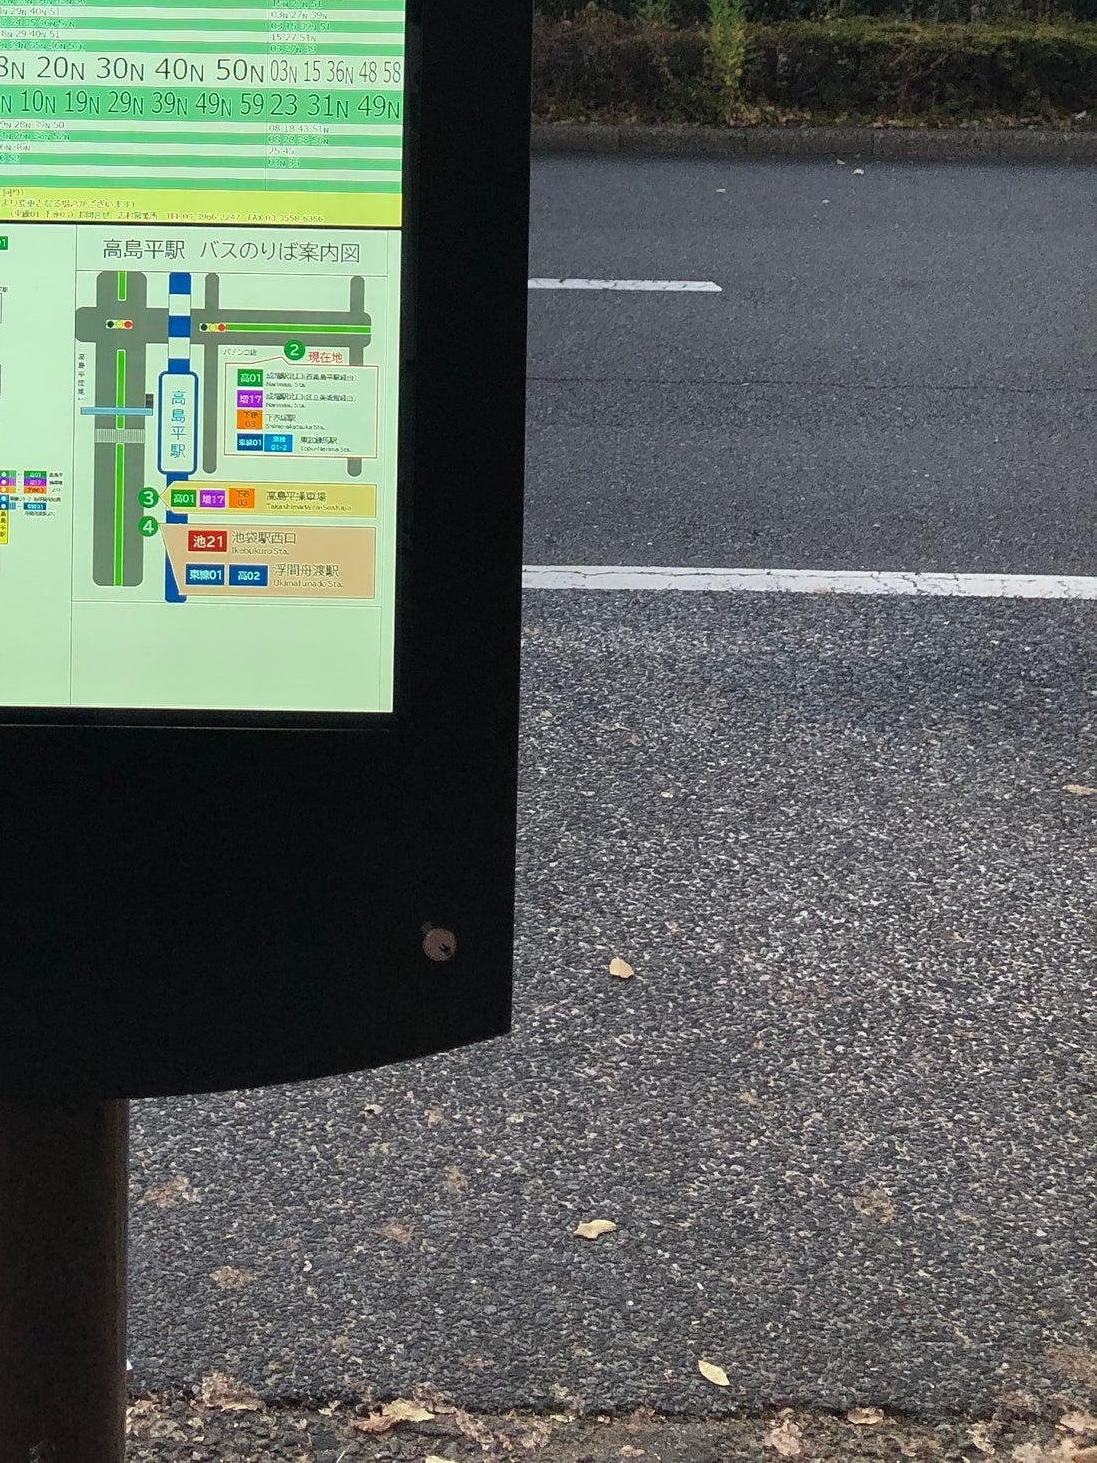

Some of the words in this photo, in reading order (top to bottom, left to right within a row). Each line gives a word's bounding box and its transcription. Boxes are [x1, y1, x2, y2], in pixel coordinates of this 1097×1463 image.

[37, 56, 85, 81] 20N
[96, 57, 144, 81] 30N
[155, 57, 204, 83] 40N
[216, 58, 264, 83] 50N
[270, 59, 297, 84] 03N
[304, 60, 321, 82] 15
[327, 61, 354, 85] 36N
[359, 61, 377, 83] 48
[383, 61, 401, 83] 58
[21, 90, 56, 114] 10N
[65, 90, 100, 115] 19N
[108, 90, 144, 115] 29N
[152, 91, 188, 116] 39N
[195, 92, 232, 117] 49N
[240, 93, 264, 115] 59
[270, 93, 298, 116] 23
[307, 94, 349, 119] 31N
[357, 95, 400, 120] 49N
[103, 238, 185, 260] 高島平駅
[200, 240, 360, 263] バスのりば案内図
[308, 350, 343, 363] 現在地
[240, 373, 261, 383] 高01
[239, 394, 262, 404] 増17
[170, 390, 187, 459] 高島平駅
[173, 493, 195, 504] 高01
[202, 494, 225, 505] 増17
[193, 534, 224, 548] 池21
[232, 531, 296, 545] 池袋駅西口
[189, 569, 222, 581] 東練01
[237, 570, 261, 581] 高02
[273, 563, 339, 577] 浮間舟渡駅
